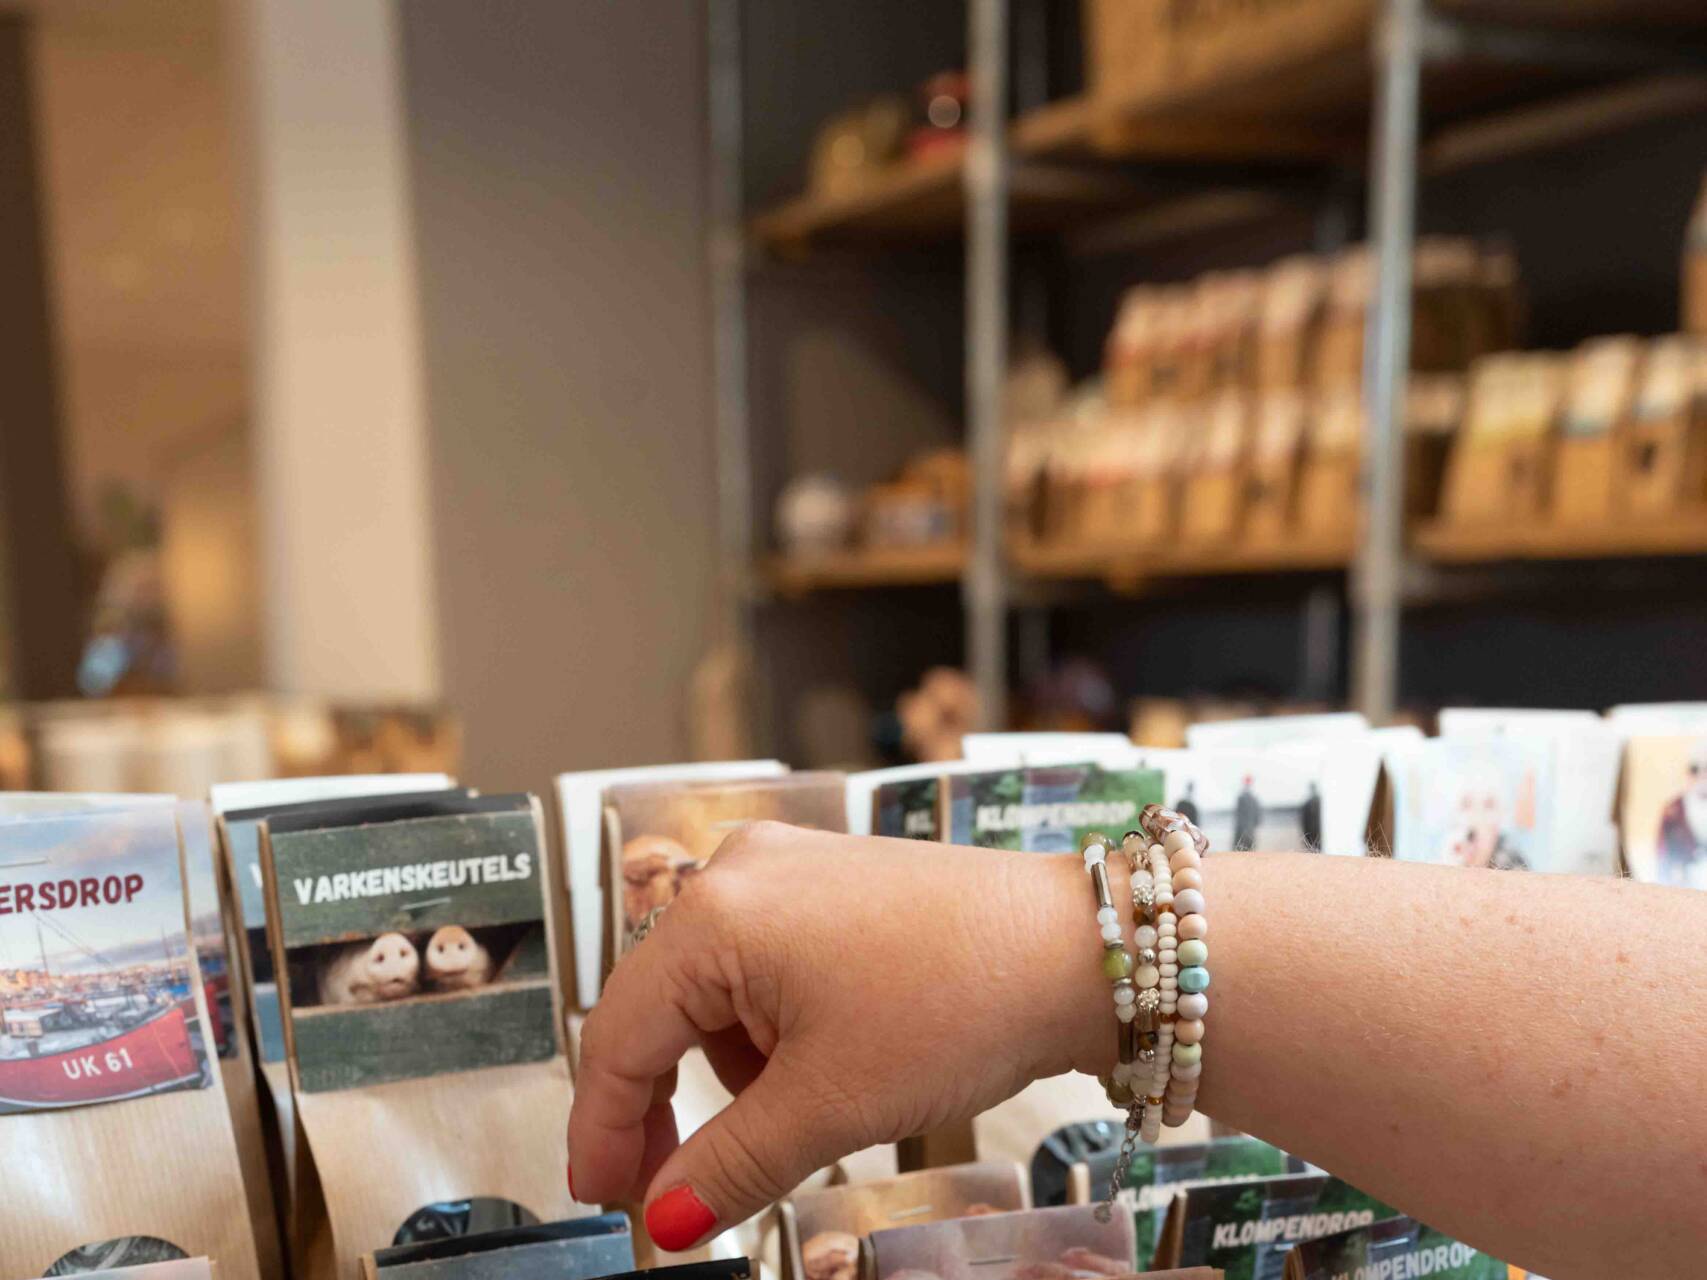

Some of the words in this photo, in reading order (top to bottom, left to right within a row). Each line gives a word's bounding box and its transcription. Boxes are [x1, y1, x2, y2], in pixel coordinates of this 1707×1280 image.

[294, 853, 531, 905] VARKENSKEUTELS
[62, 1055, 102, 1080] UK
[104, 1048, 133, 1072] 61
